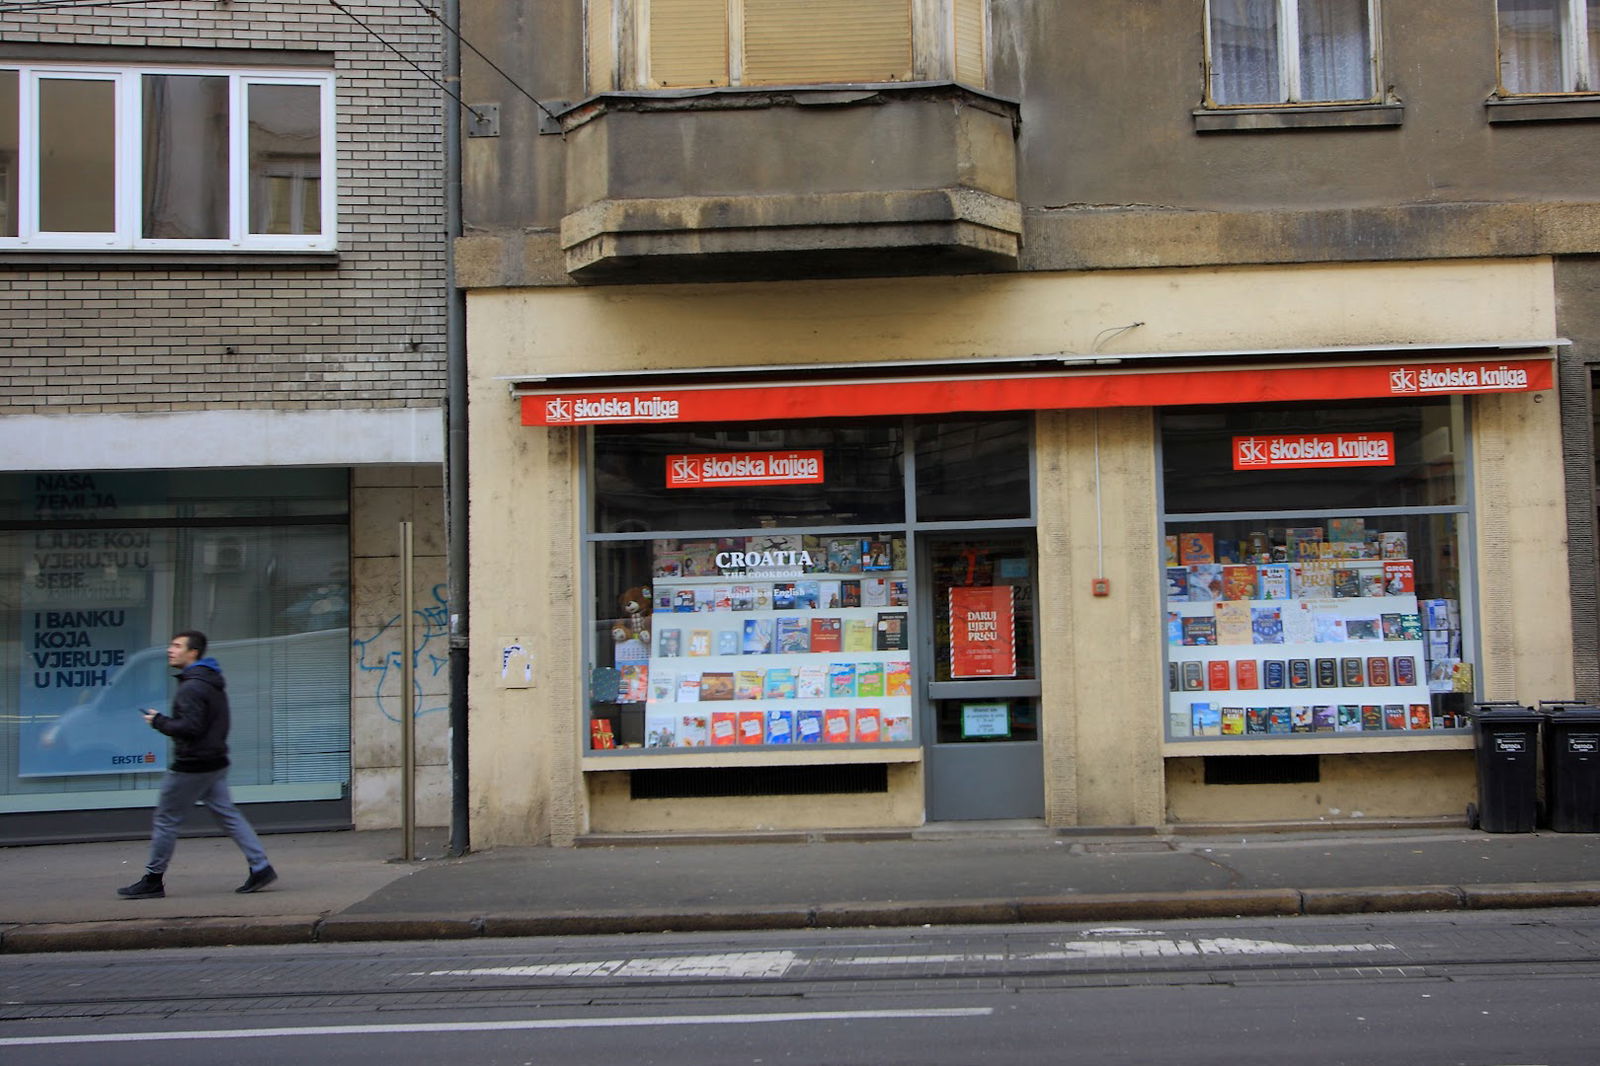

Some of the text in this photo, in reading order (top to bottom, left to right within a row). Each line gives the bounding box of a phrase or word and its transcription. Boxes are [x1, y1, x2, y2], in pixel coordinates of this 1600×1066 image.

[1419, 368, 1477, 387] školska
[1481, 366, 1528, 388] knjiga
[574, 398, 631, 417] školska
[634, 397, 679, 418] knjiga
[1270, 439, 1334, 460] školska
[1338, 436, 1388, 459] knjiga
[702, 457, 765, 477] školska
[769, 454, 818, 477] knjiga
[104, 532, 151, 549] KOJI
[134, 551, 149, 569] U
[715, 550, 814, 568] CROATIA
[774, 587, 805, 599] English
[35, 610, 124, 629] I BANKU
[967, 611, 997, 621] DARUJ
[35, 631, 91, 649] KOJA
[33, 649, 125, 668] VJERUJE
[35, 671, 50, 688] U
[112, 755, 143, 765] ERSTE
